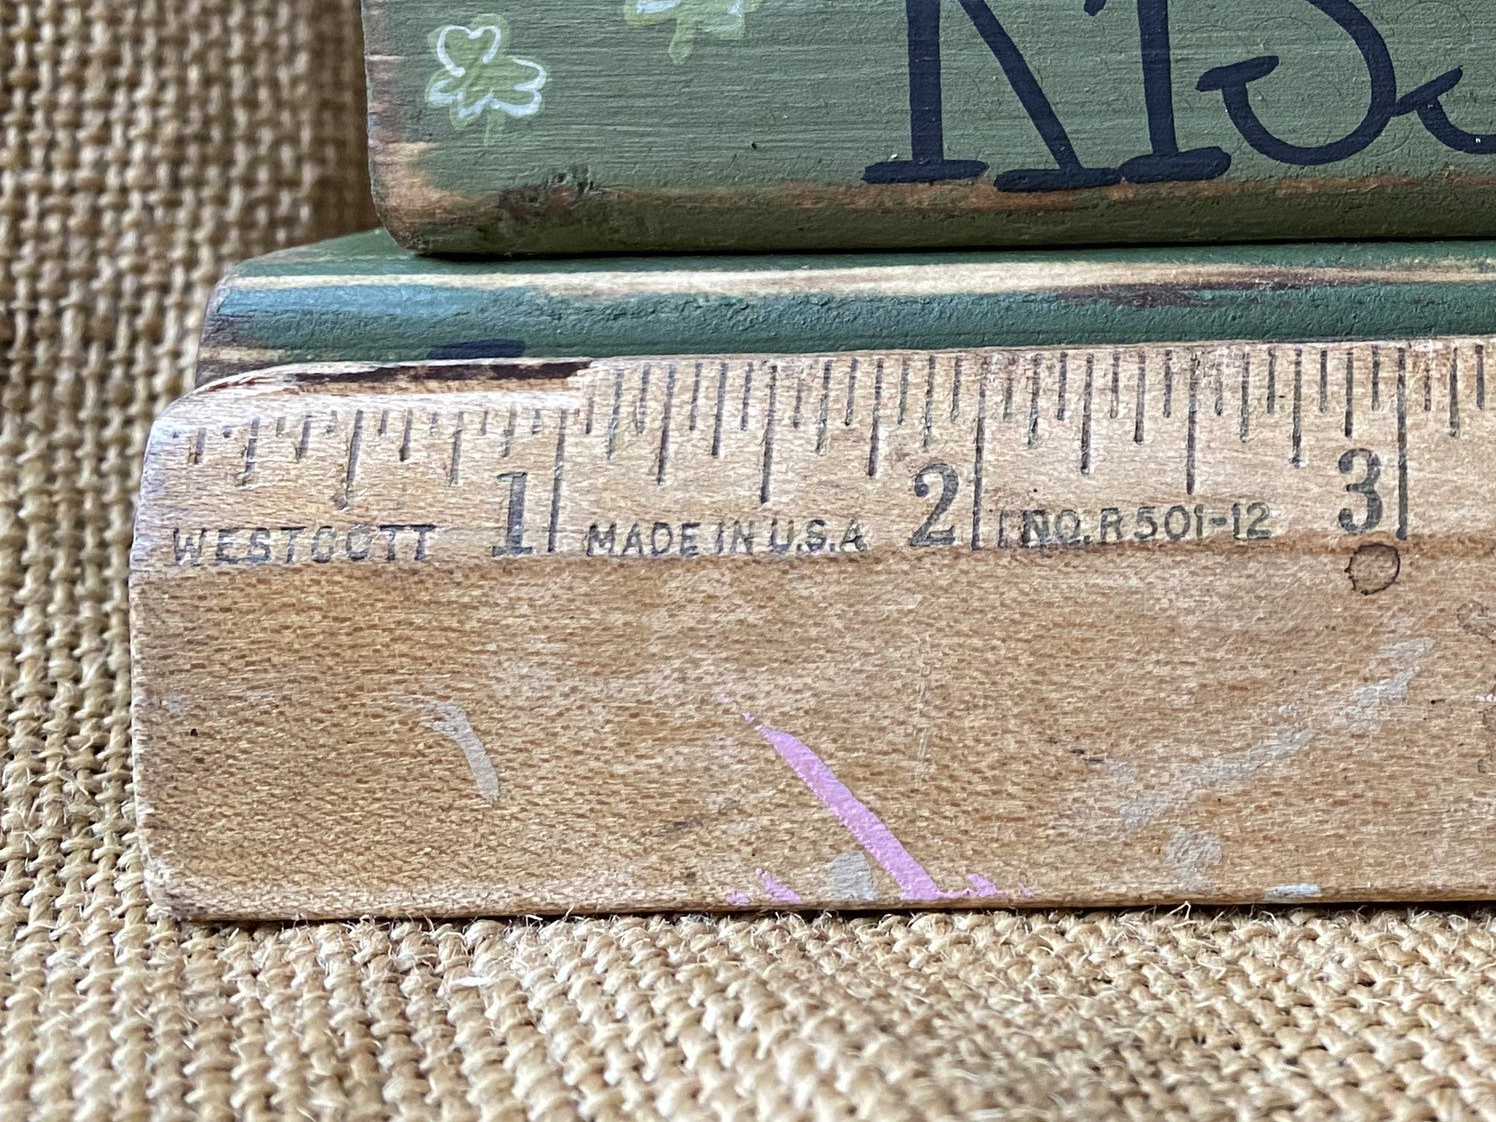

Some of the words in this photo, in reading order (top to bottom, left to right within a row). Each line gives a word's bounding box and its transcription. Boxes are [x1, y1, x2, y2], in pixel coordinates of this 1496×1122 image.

[491, 471, 533, 557] 1
[909, 462, 960, 549] 2
[1337, 448, 1384, 535] 3
[172, 524, 437, 565] WESTCOTT
[584, 521, 701, 558] MADE
[713, 520, 755, 556] IN
